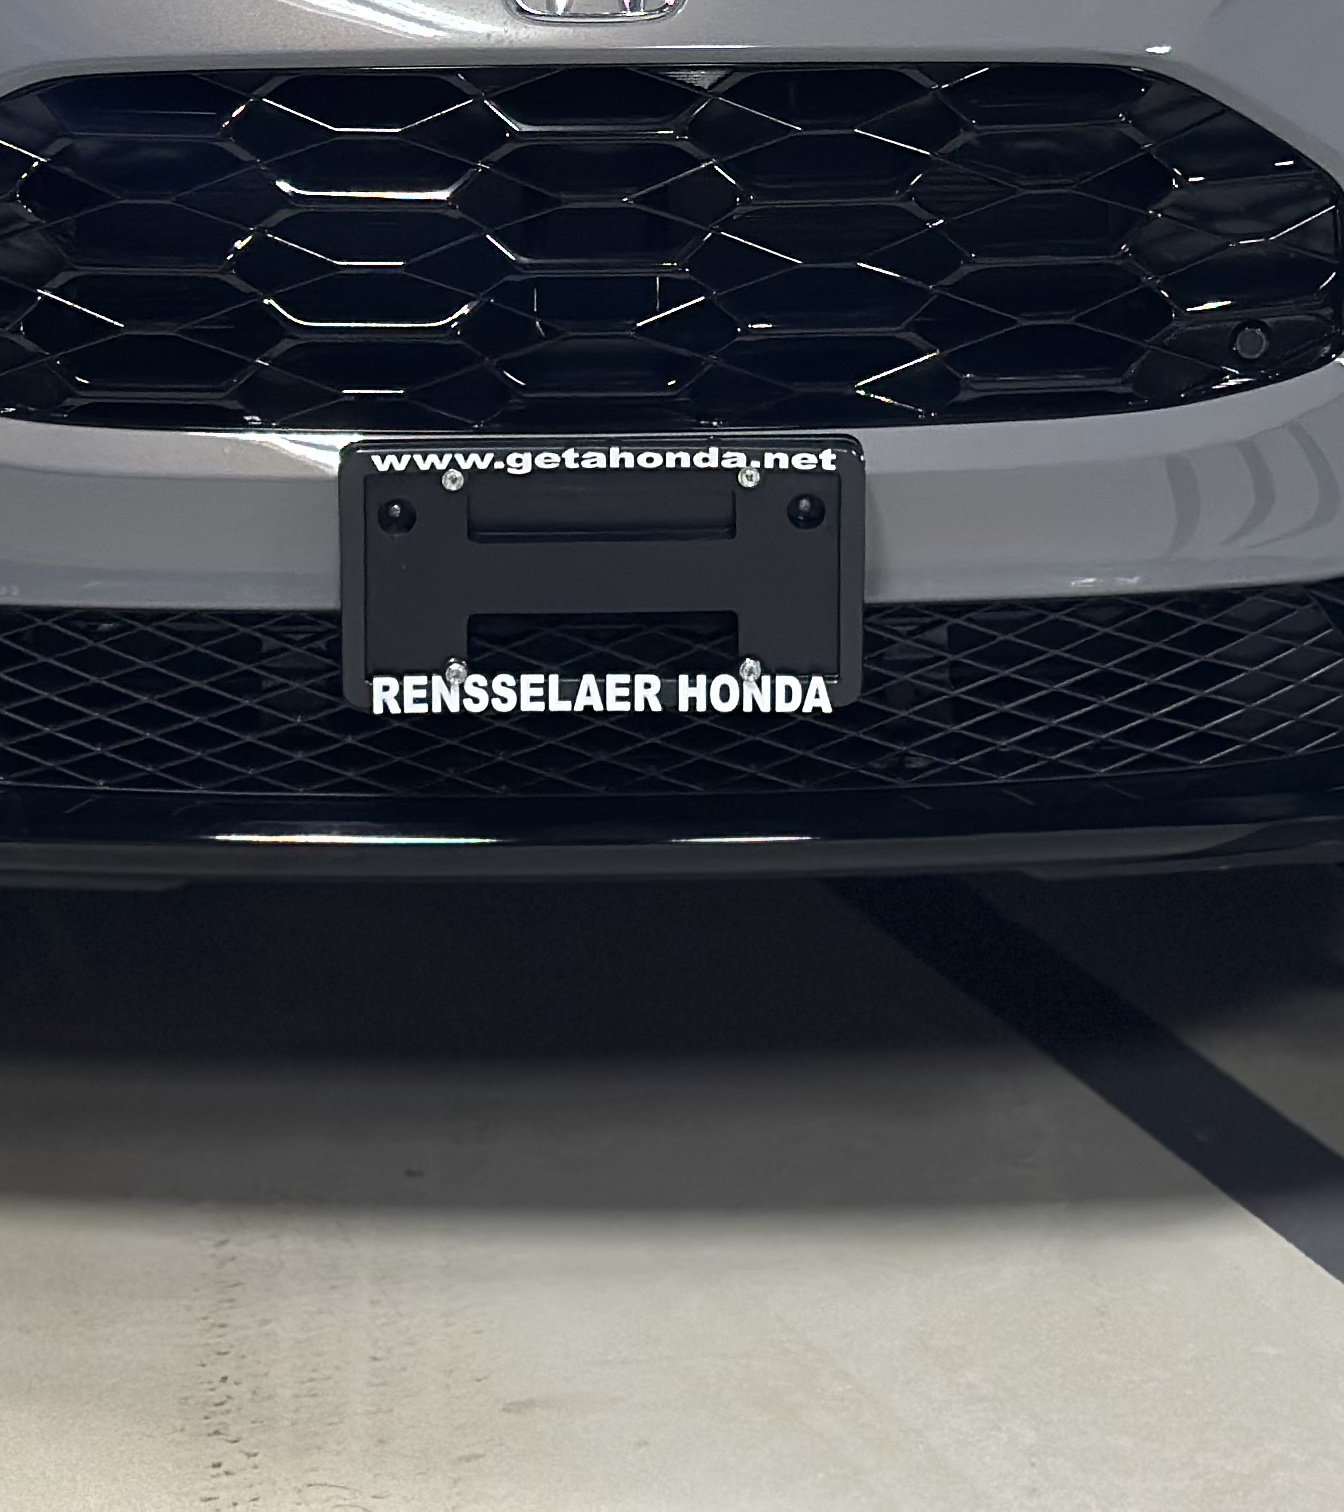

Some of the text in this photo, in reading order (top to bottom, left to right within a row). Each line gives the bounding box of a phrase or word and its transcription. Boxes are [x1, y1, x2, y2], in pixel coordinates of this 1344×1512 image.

[371, 447, 837, 474] www.getahonda.net
[372, 674, 833, 714] RENSSELAER HONDA
